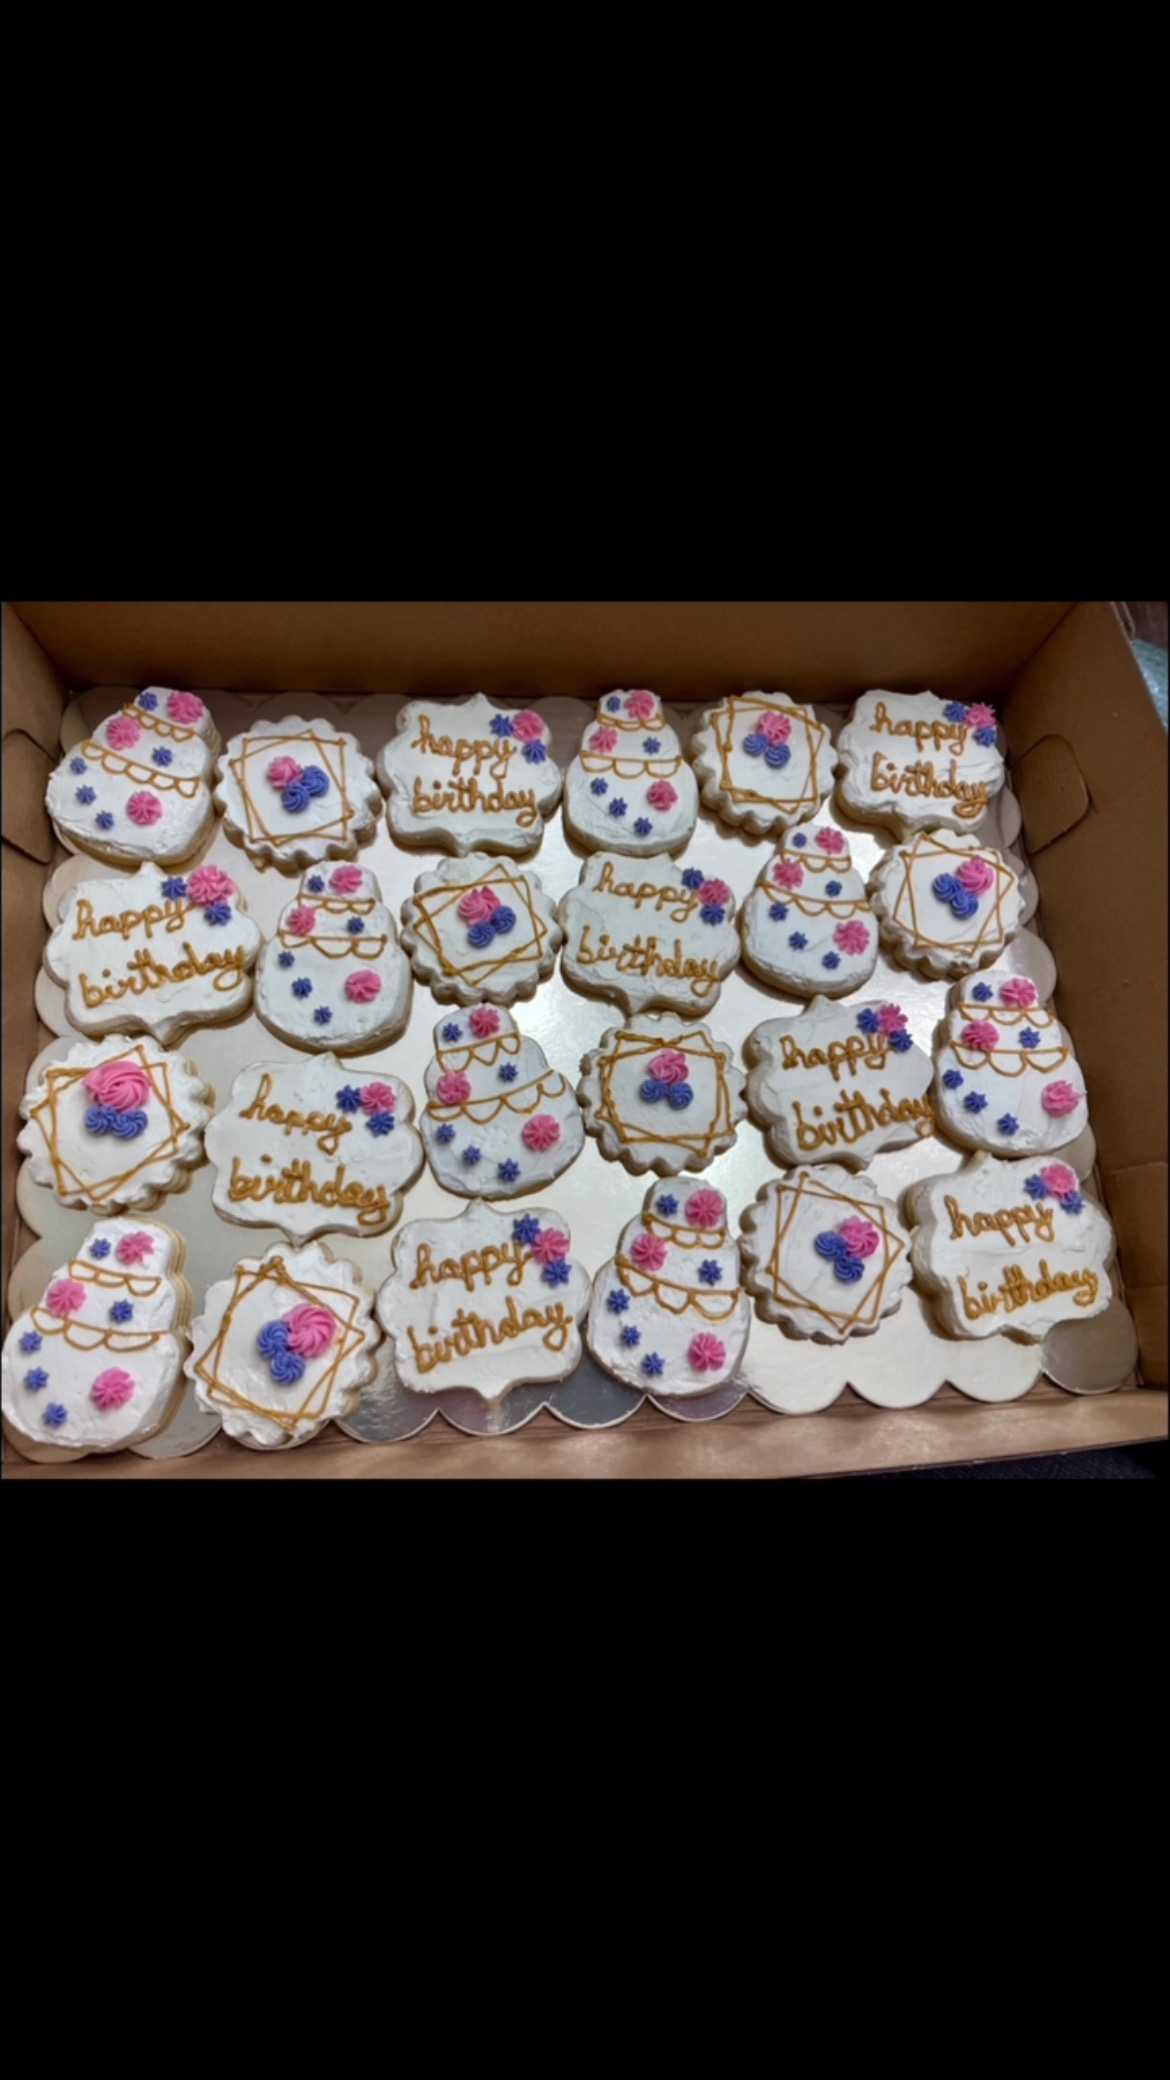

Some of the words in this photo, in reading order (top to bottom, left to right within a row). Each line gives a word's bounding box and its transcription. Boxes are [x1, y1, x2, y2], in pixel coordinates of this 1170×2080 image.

[411, 714, 517, 779] happy
[869, 701, 967, 756] happy
[413, 776, 537, 828] birthday
[871, 752, 989, 818] birthday
[72, 899, 199, 939] happy
[592, 861, 700, 922] happy
[79, 942, 245, 1009] birthday
[577, 925, 720, 997] birthday
[779, 1035, 894, 1082] happy
[792, 1088, 935, 1151] birthday
[228, 1154, 390, 1226] birthday
[944, 1195, 1055, 1247] happy
[409, 1243, 533, 1291] happy
[958, 1259, 1099, 1320] birthday
[407, 1296, 573, 1374] birthday
